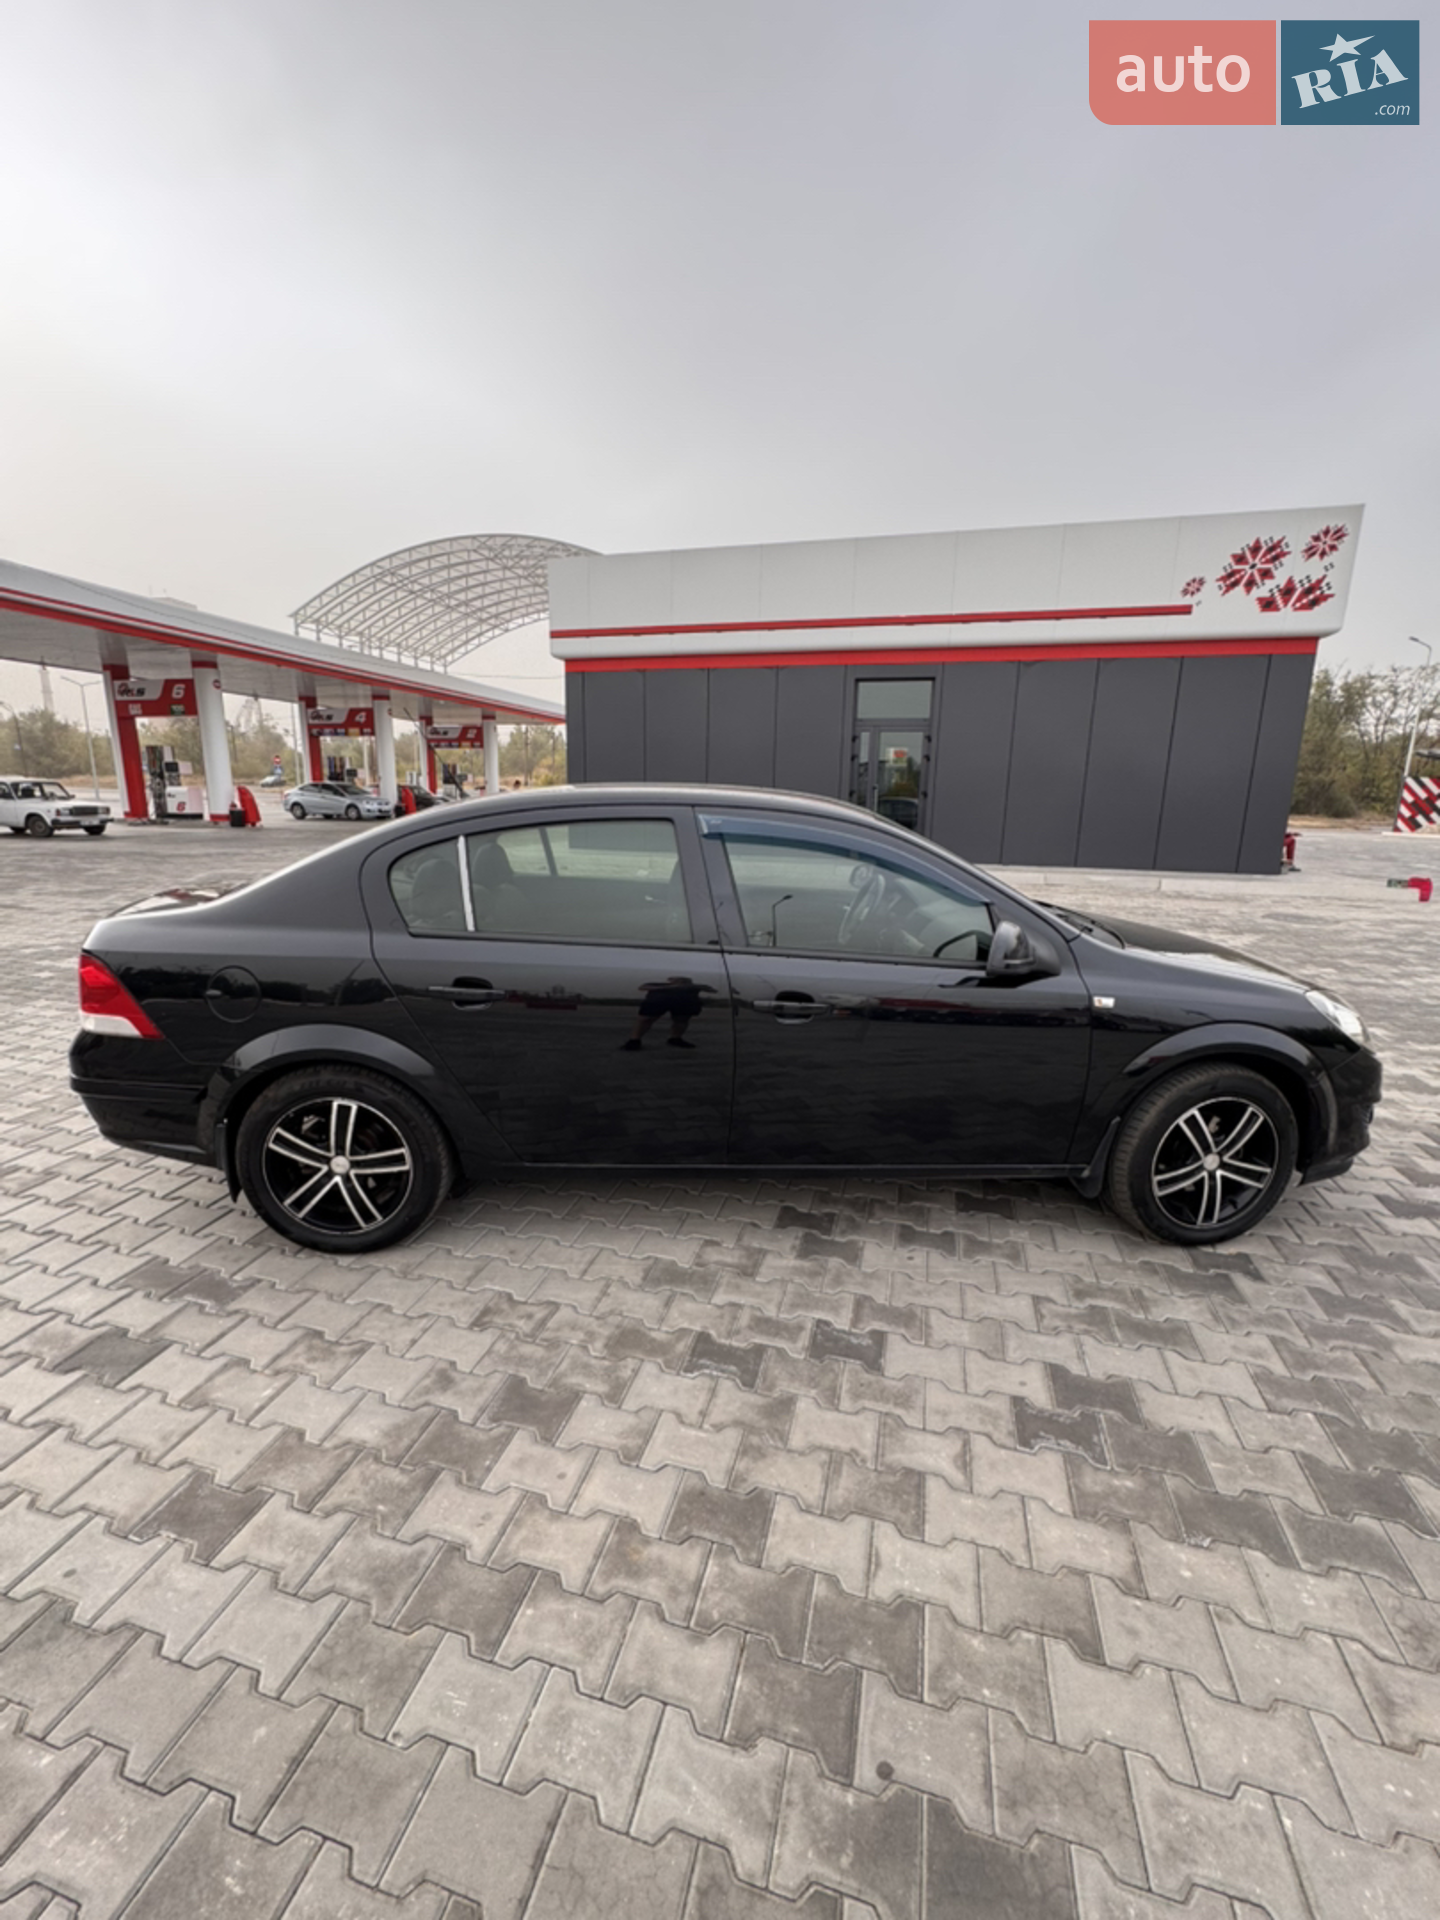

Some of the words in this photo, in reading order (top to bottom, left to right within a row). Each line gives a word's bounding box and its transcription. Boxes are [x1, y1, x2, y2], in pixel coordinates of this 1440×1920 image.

[171, 683, 186, 699] 6
[355, 711, 367, 724] 4
[176, 801, 186, 813] 6
